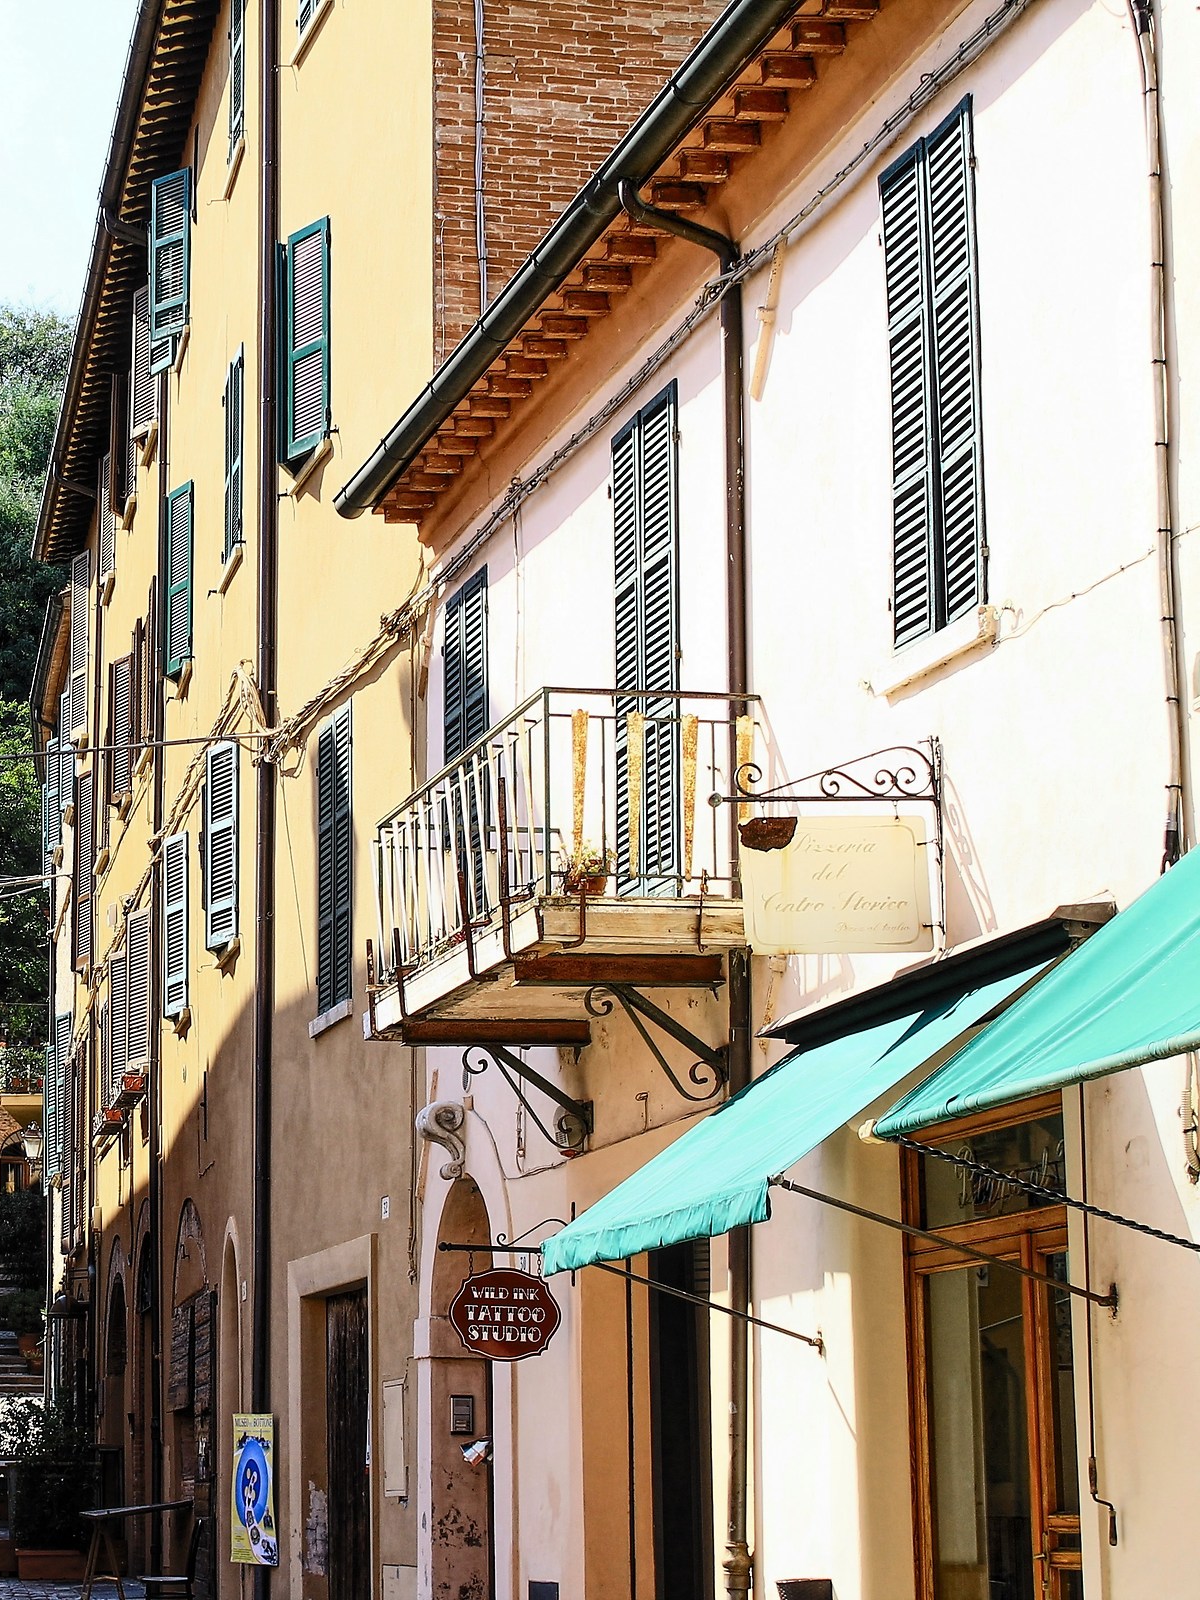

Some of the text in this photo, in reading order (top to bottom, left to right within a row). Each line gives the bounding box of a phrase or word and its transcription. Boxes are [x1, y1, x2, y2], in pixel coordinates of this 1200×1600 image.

[794, 832, 877, 853] Pizzeria
[811, 863, 849, 881] del
[761, 890, 909, 913] Centro Storico
[471, 1286, 540, 1301] WILD INK
[464, 1304, 546, 1323] TATTOO
[468, 1324, 542, 1343] STUDIO
